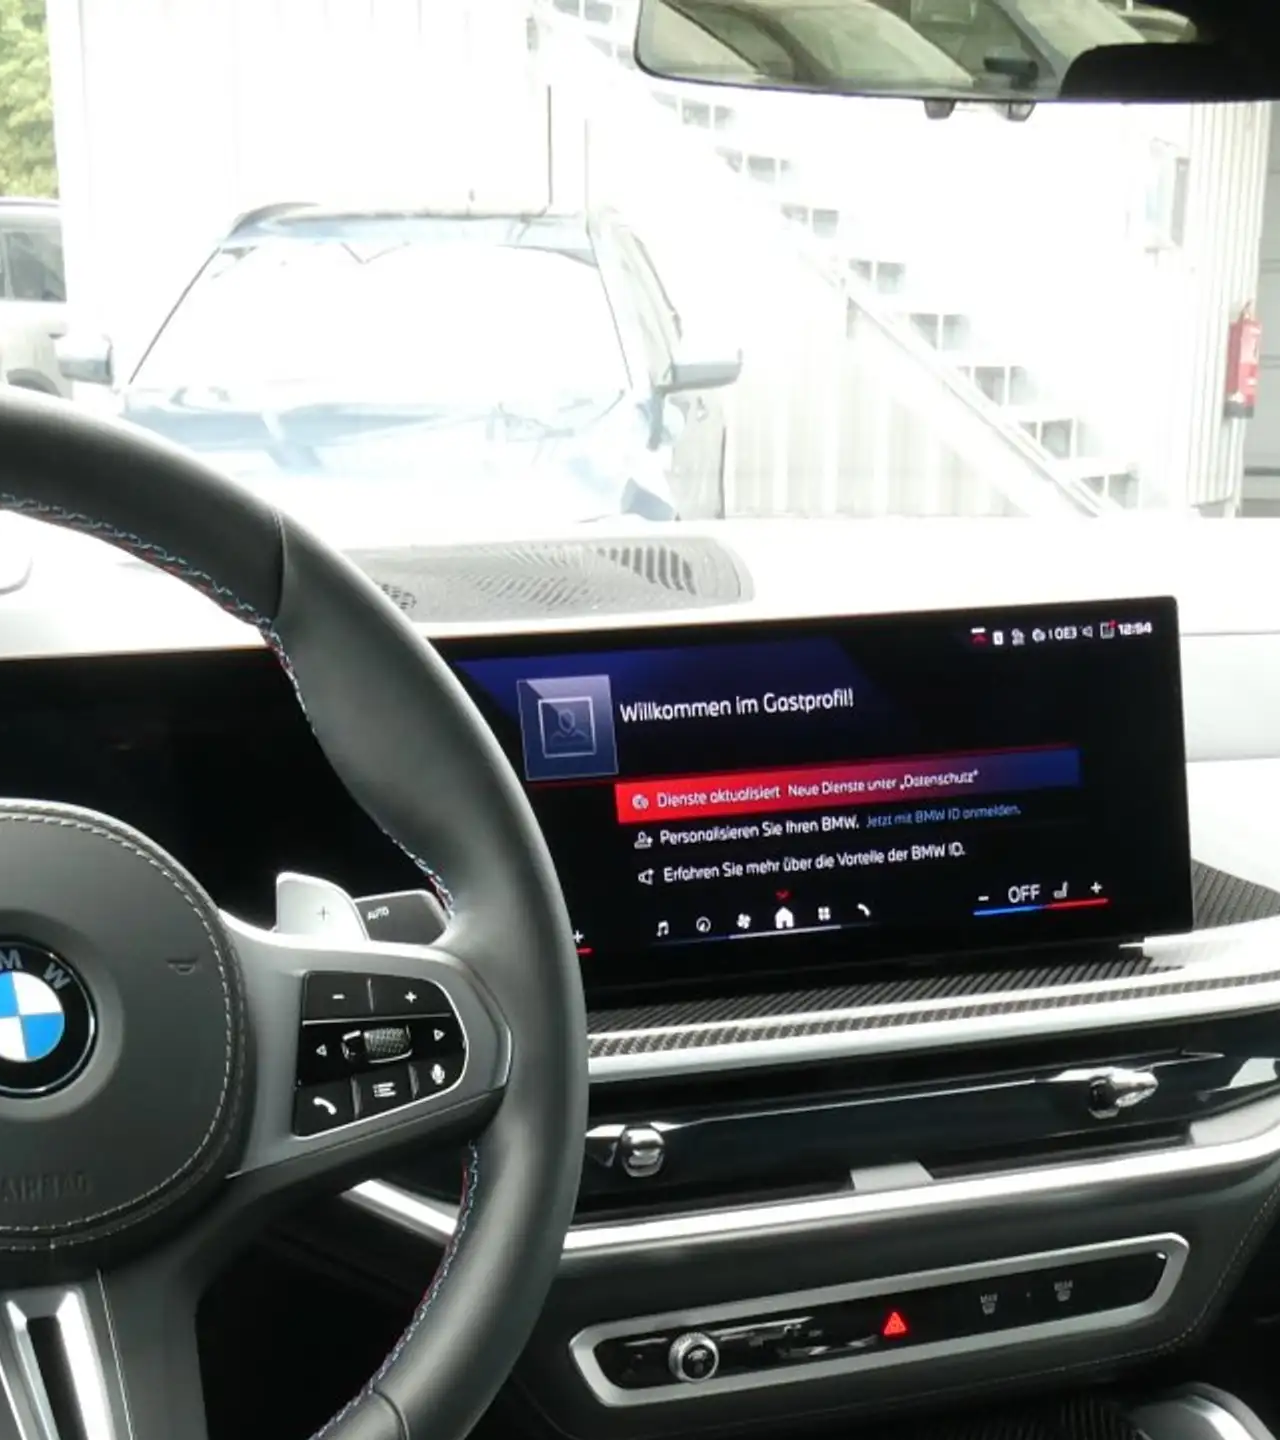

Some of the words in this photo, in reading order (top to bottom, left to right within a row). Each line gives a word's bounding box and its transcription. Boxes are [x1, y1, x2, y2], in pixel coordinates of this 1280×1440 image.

[619, 701, 732, 724] Willkommen
[735, 696, 759, 715] im
[763, 687, 854, 713] Gastprofil!
[656, 793, 707, 808] Dienste
[709, 785, 781, 803] aktualisiert
[787, 783, 820, 797] Neue
[821, 779, 866, 795] Dienste
[659, 826, 760, 846] Personalisieren
[761, 820, 784, 838] Sie
[786, 819, 819, 834] Ihren
[821, 814, 860, 832] BMW.
[894, 813, 914, 825] mit
[915, 810, 946, 823] BMW
[948, 808, 961, 819] ID
[663, 865, 721, 883] Erfahren
[722, 861, 744, 878] Sie
[746, 860, 781, 875] mehr
[783, 855, 813, 872] über
[814, 852, 836, 870] die
[836, 848, 886, 867] Vorteile
[887, 846, 910, 863] der
[911, 842, 946, 860] BMW
[1007, 883, 1041, 904] OFF
